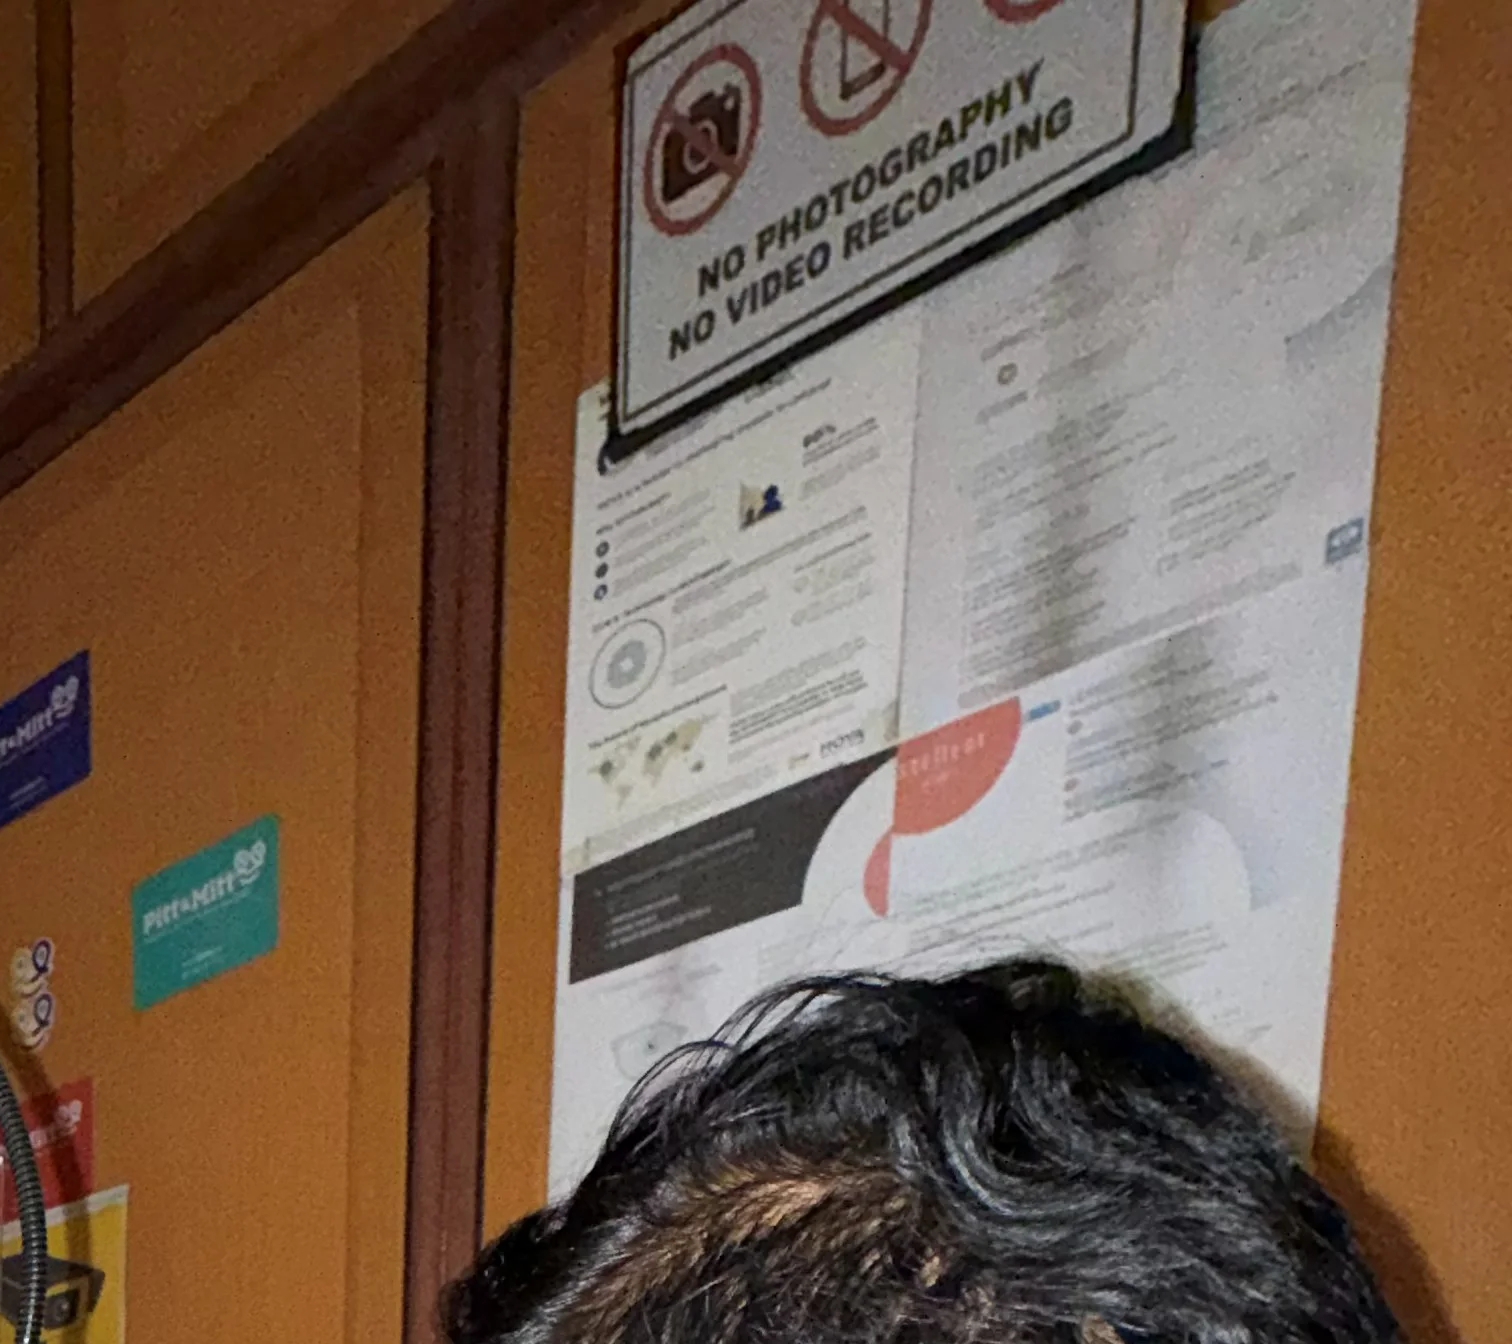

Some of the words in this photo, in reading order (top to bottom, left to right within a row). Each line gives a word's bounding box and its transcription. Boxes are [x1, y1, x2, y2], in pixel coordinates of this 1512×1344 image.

[669, 309, 715, 360] NO
[726, 241, 831, 325] VIDEO
[843, 96, 1073, 261] RECORDING
[698, 245, 745, 298] NO
[756, 57, 1044, 262] PHOTOGRAPHY
